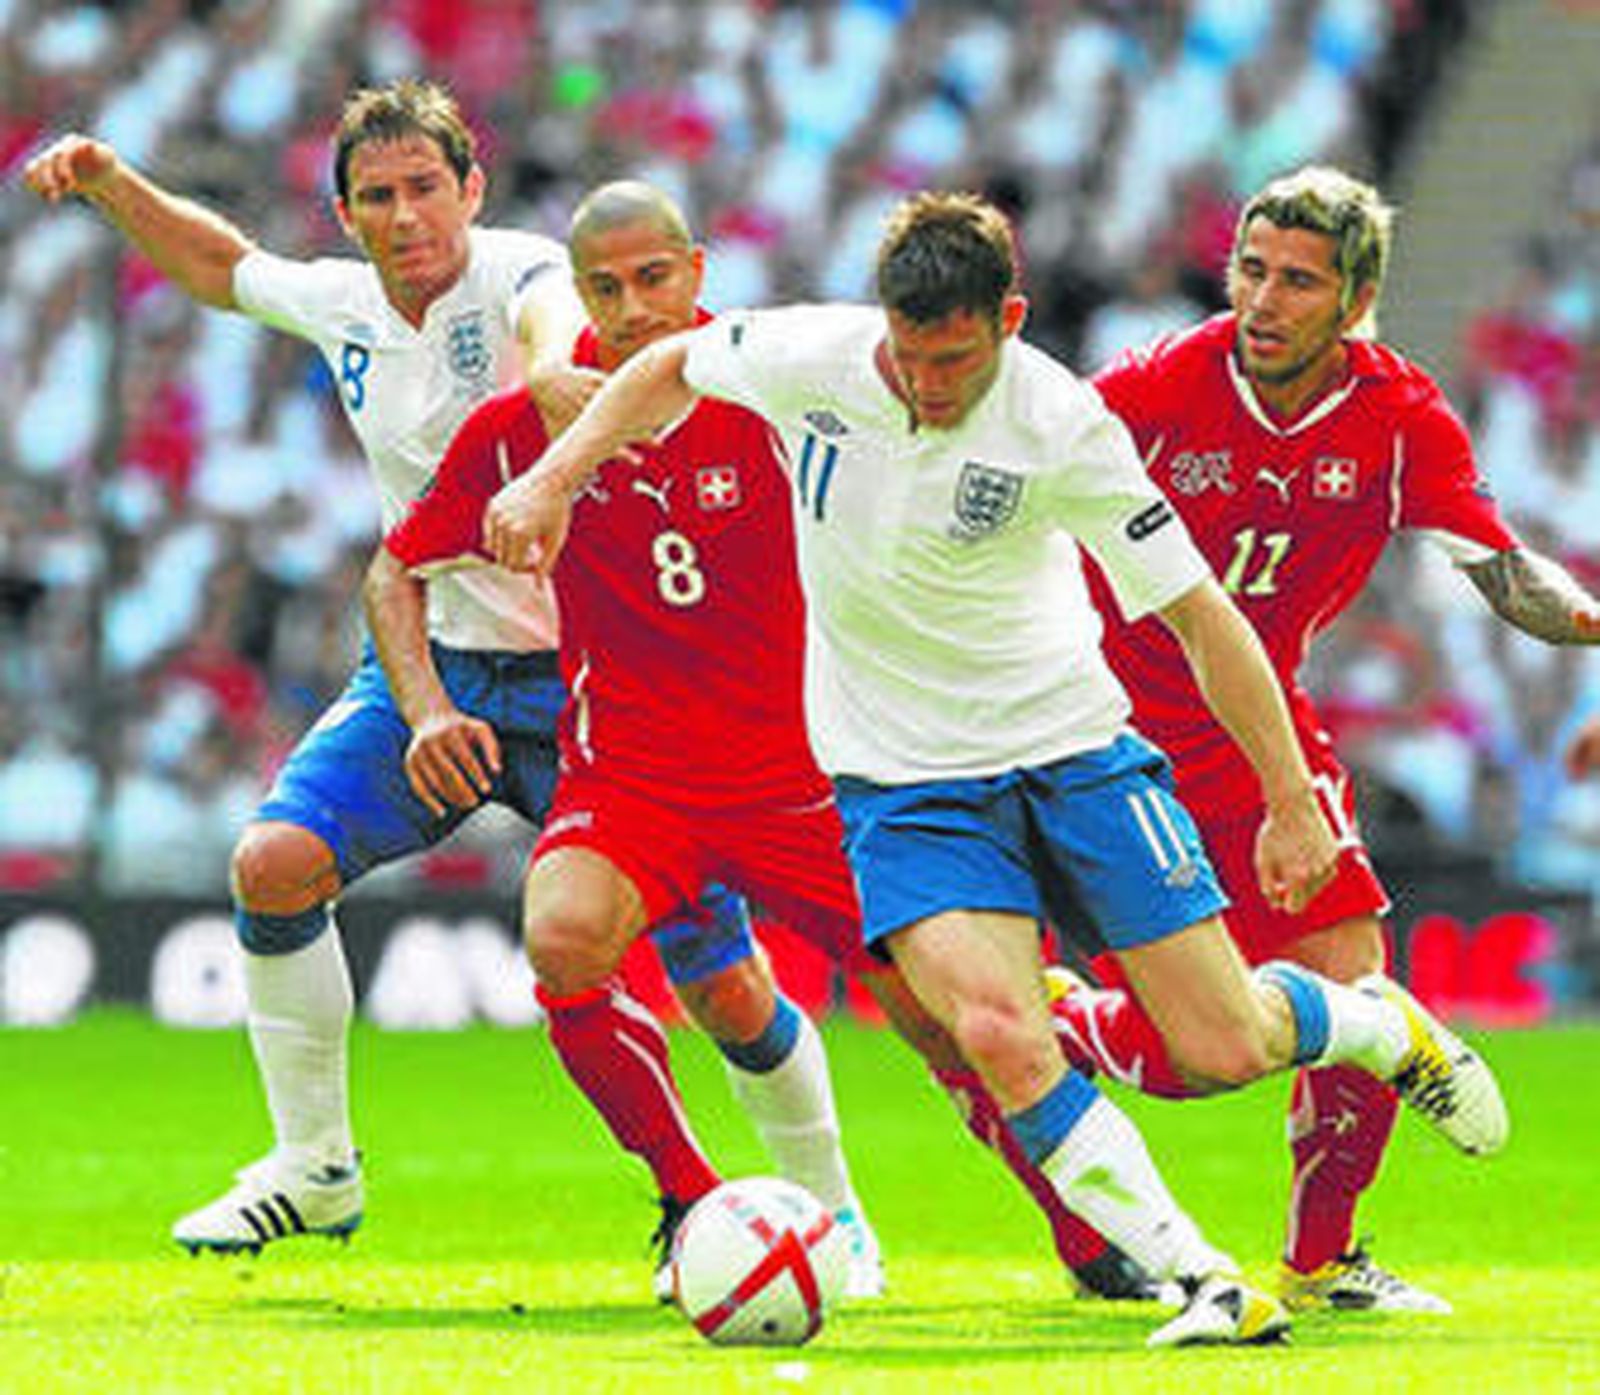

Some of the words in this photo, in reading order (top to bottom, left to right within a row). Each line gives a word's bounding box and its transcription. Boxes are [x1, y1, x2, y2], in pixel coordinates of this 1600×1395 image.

[342, 342, 370, 412] 8
[799, 433, 838, 521] 11
[652, 532, 705, 606] 8
[1223, 528, 1292, 595] 11
[1127, 788, 1189, 869] 11
